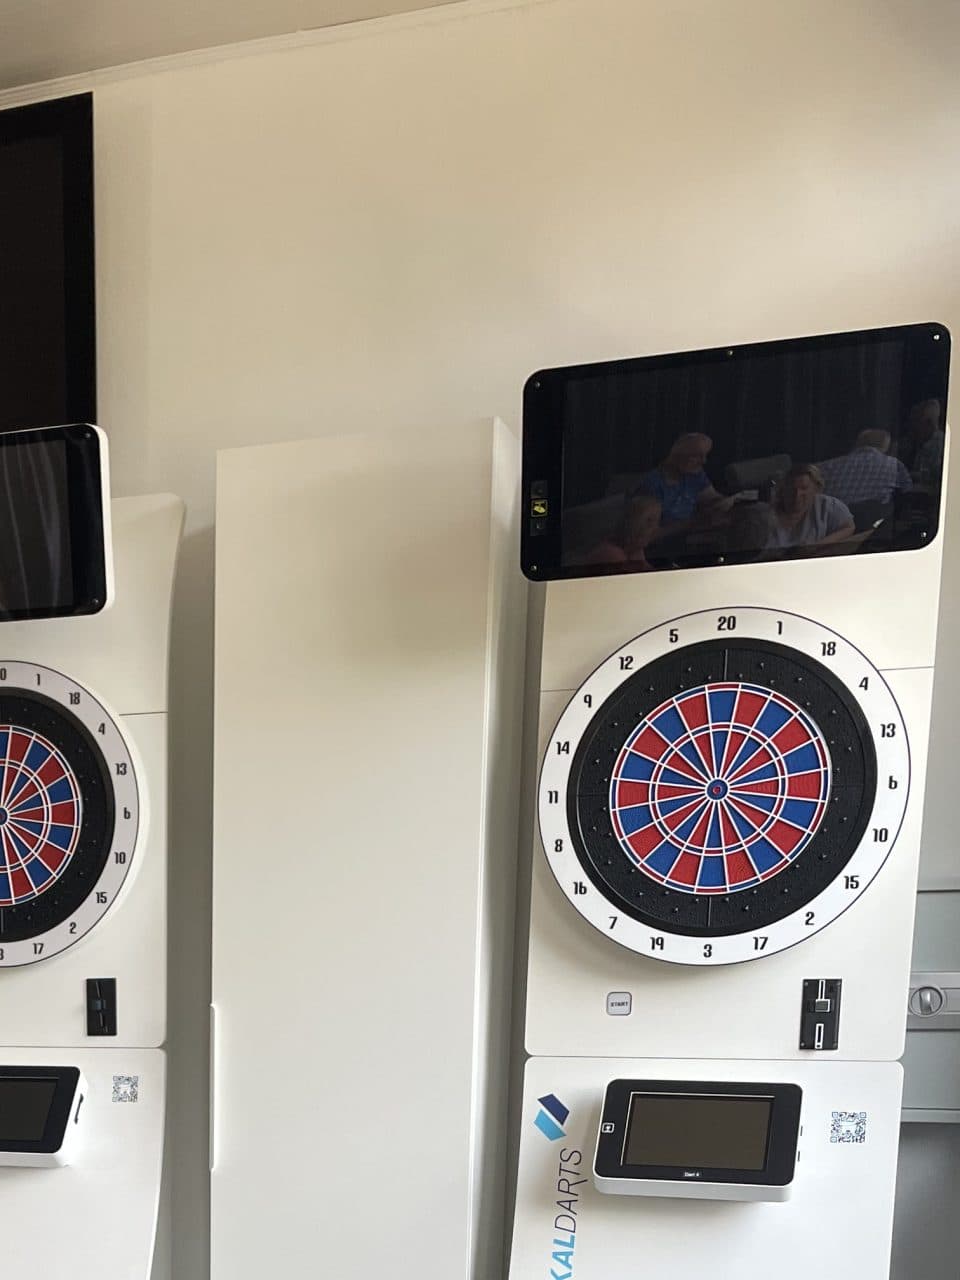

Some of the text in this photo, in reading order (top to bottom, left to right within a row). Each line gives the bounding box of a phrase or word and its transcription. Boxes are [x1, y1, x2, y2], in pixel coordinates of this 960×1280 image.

[717, 615, 737, 632] 20
[776, 620, 783, 636] 1
[669, 628, 679, 644] 5
[820, 641, 837, 657] 18
[618, 655, 634, 671] 12
[858, 676, 869, 691] 4
[68, 691, 81, 706] 18
[583, 694, 593, 709] 9
[97, 722, 106, 736] 4
[880, 722, 897, 738] 13
[556, 740, 570, 756] 14
[115, 762, 128, 776] 13
[547, 790, 559, 804] 11
[872, 827, 889, 843] 10
[554, 838, 564, 853] 8
[114, 851, 127, 865] 10
[573, 881, 588, 895] 16
[843, 874, 860, 890] 15
[95, 891, 108, 904] 15
[608, 916, 618, 930] 7
[804, 911, 815, 926] 2
[69, 921, 77, 935] 2
[32, 942, 45, 955] 17
[650, 936, 665, 951] 19
[703, 943, 713, 959] 3
[752, 936, 769, 951] 17
